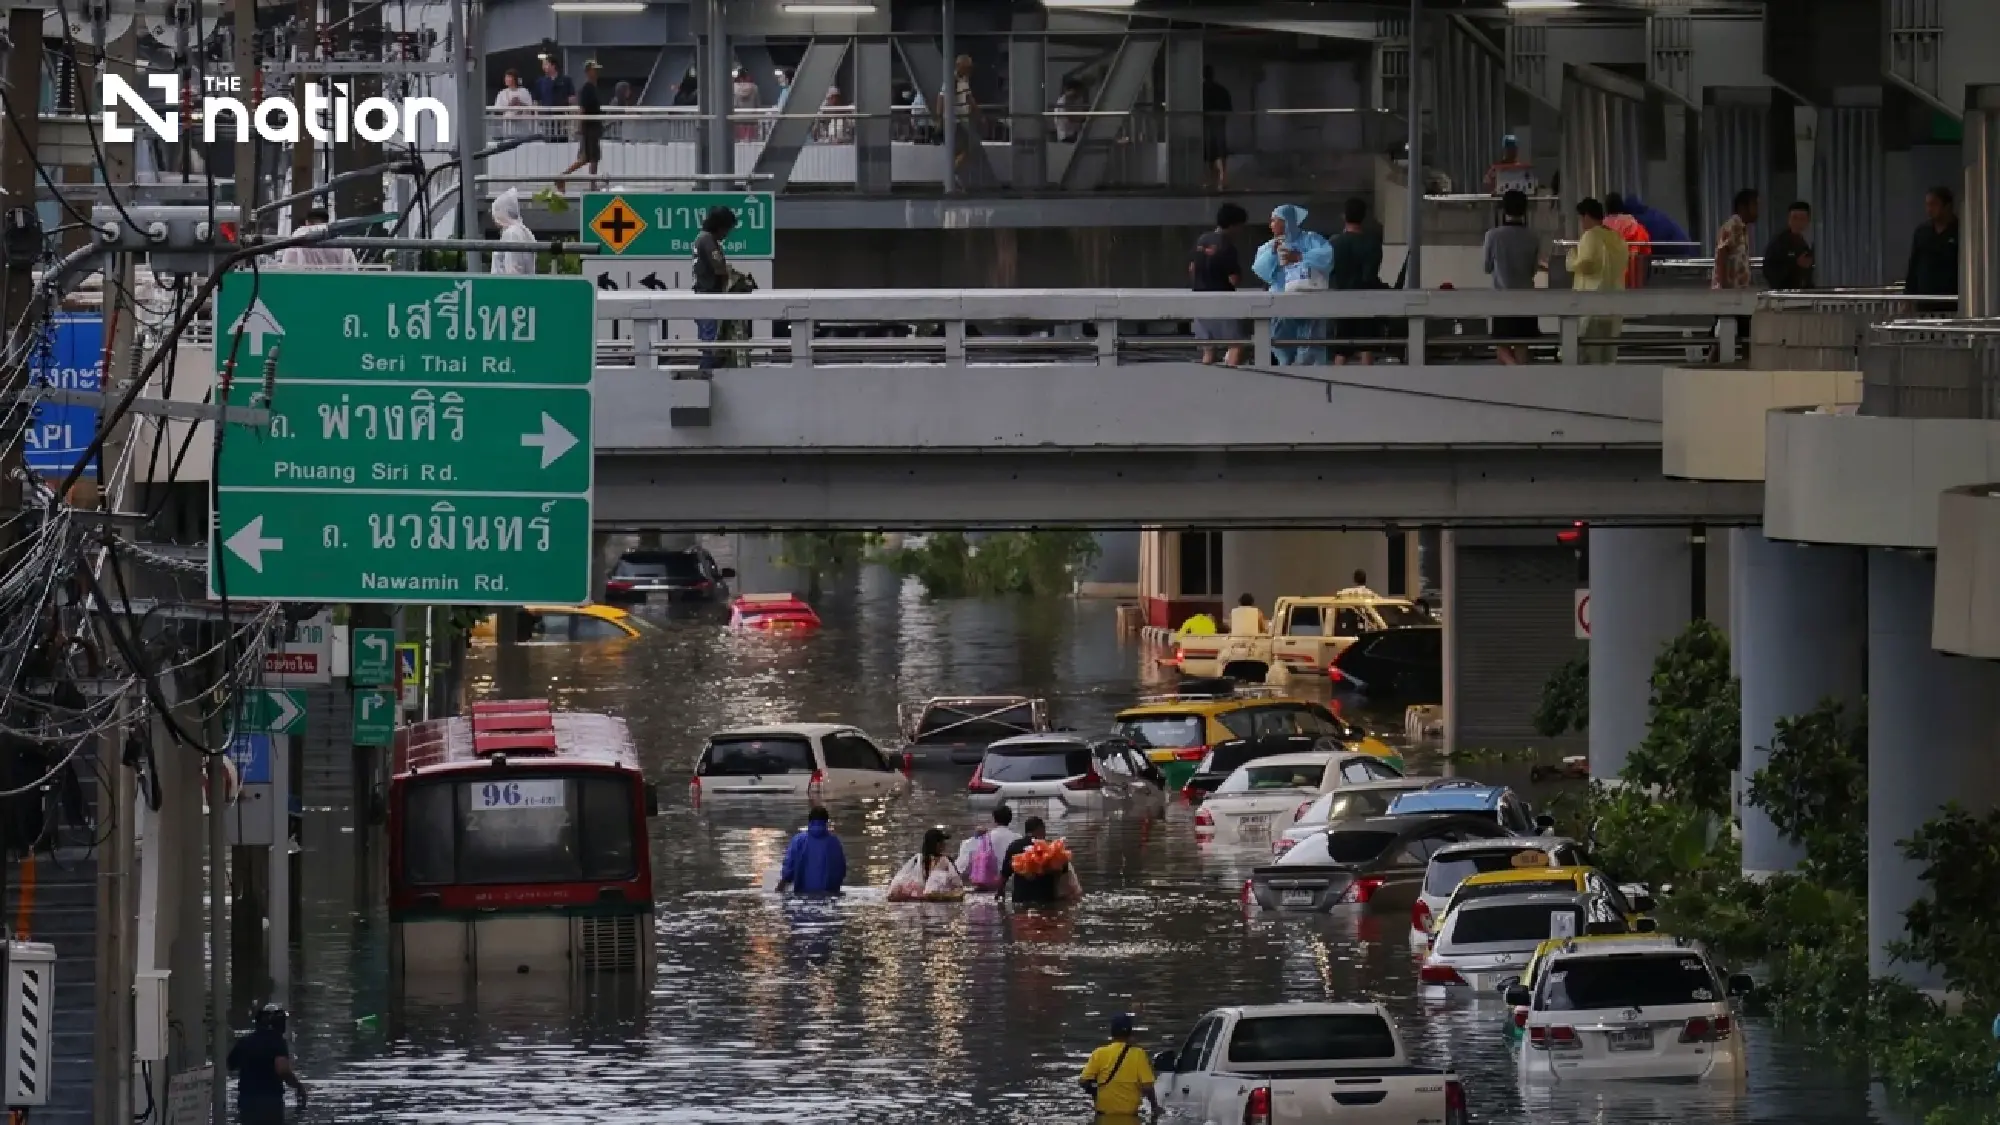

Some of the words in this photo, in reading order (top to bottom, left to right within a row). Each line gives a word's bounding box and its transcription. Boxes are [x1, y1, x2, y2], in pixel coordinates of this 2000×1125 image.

[343, 313, 368, 338] ถ.
[387, 280, 536, 341] เสรีไทย
[361, 354, 405, 372] Seri
[422, 355, 467, 373] Thai
[482, 356, 515, 374] Rd.
[317, 388, 465, 441] พ่วงศิริ
[274, 461, 356, 483] Phuang
[371, 462, 409, 481] Siri
[421, 464, 458, 481] Rd.
[322, 524, 348, 549] ถ.
[368, 499, 558, 552] นวมินทร์
[361, 572, 459, 591] Nawamin
[474, 574, 509, 592] Rd.
[483, 783, 521, 807] 96
